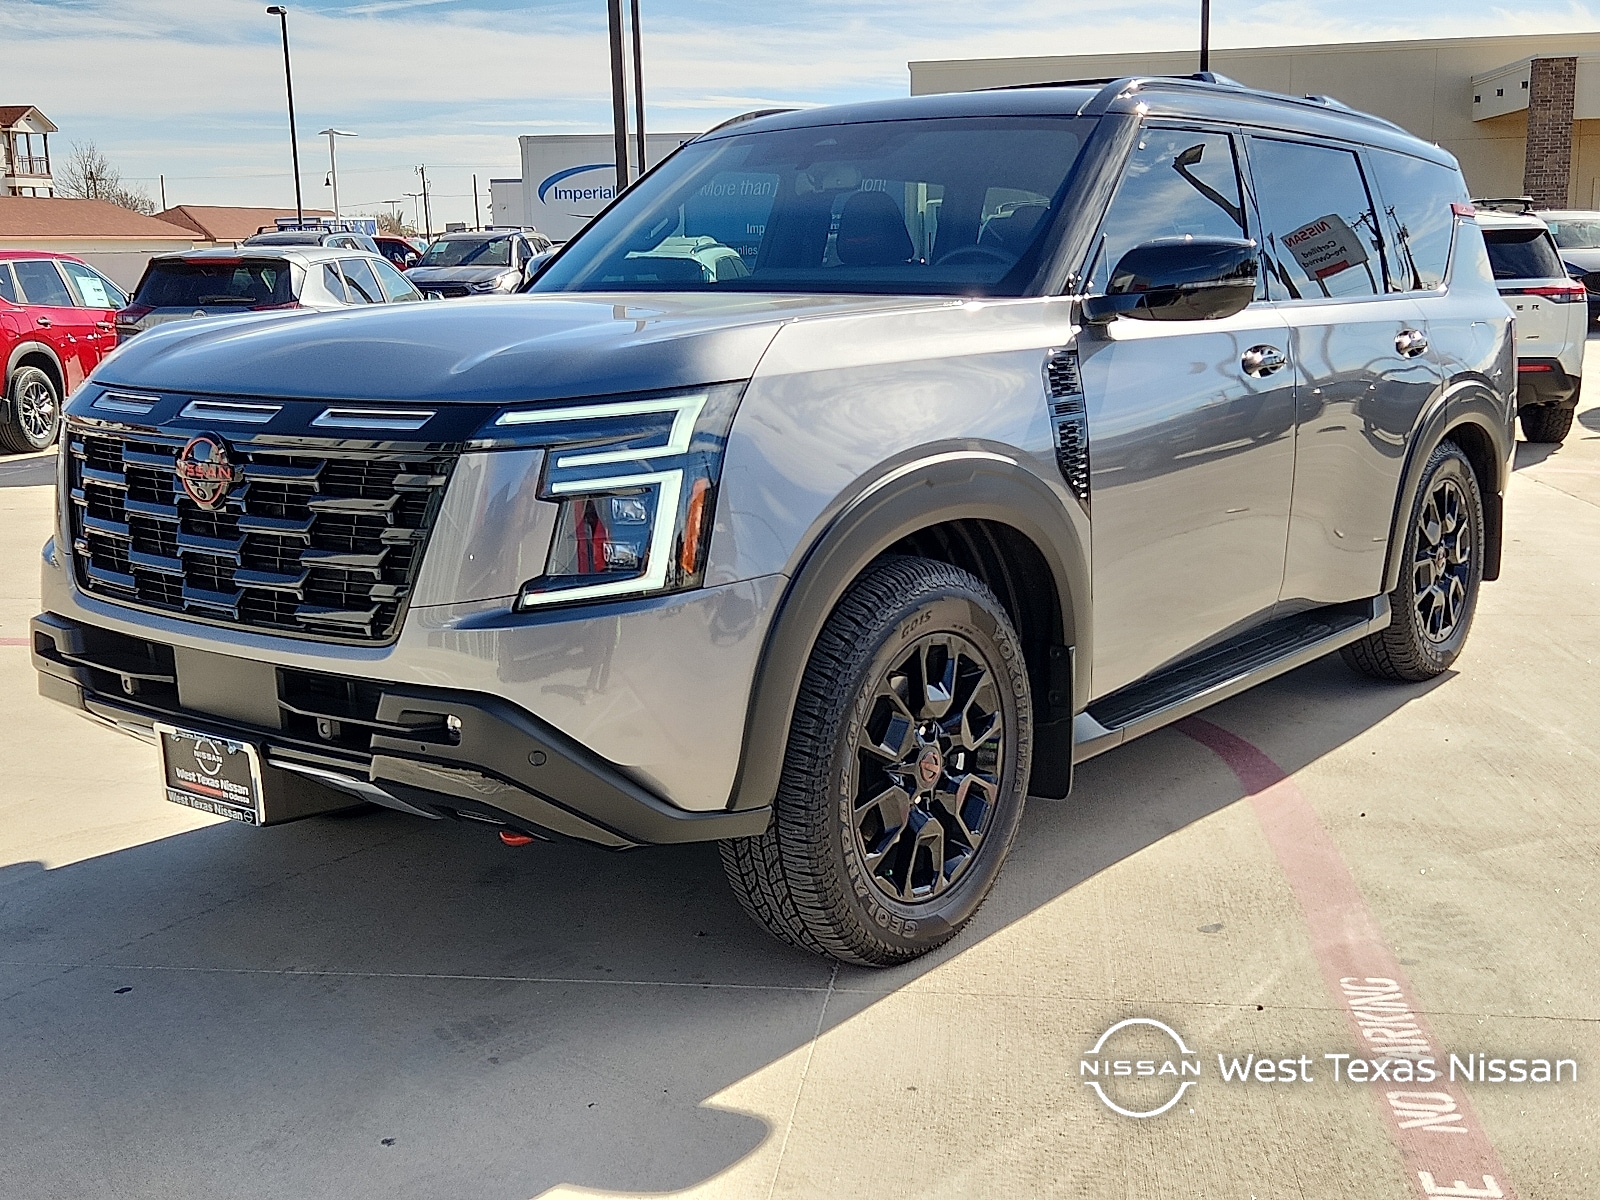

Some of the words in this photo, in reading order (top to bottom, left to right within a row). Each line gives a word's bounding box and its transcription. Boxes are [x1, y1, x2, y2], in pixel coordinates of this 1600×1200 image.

[554, 185, 617, 202] Imperial
[740, 180, 771, 196] than
[746, 223, 765, 236] Imp
[176, 462, 231, 479] SSAN
[193, 749, 223, 764] NISSAN
[175, 767, 197, 783] West
[195, 772, 220, 789] Texas
[220, 779, 250, 796] Nissan
[167, 790, 189, 806] West
[188, 796, 214, 813] Texas
[213, 803, 244, 821] Nissan
[1386, 1090, 1469, 1133] NO
[1417, 1171, 1504, 1200] E
